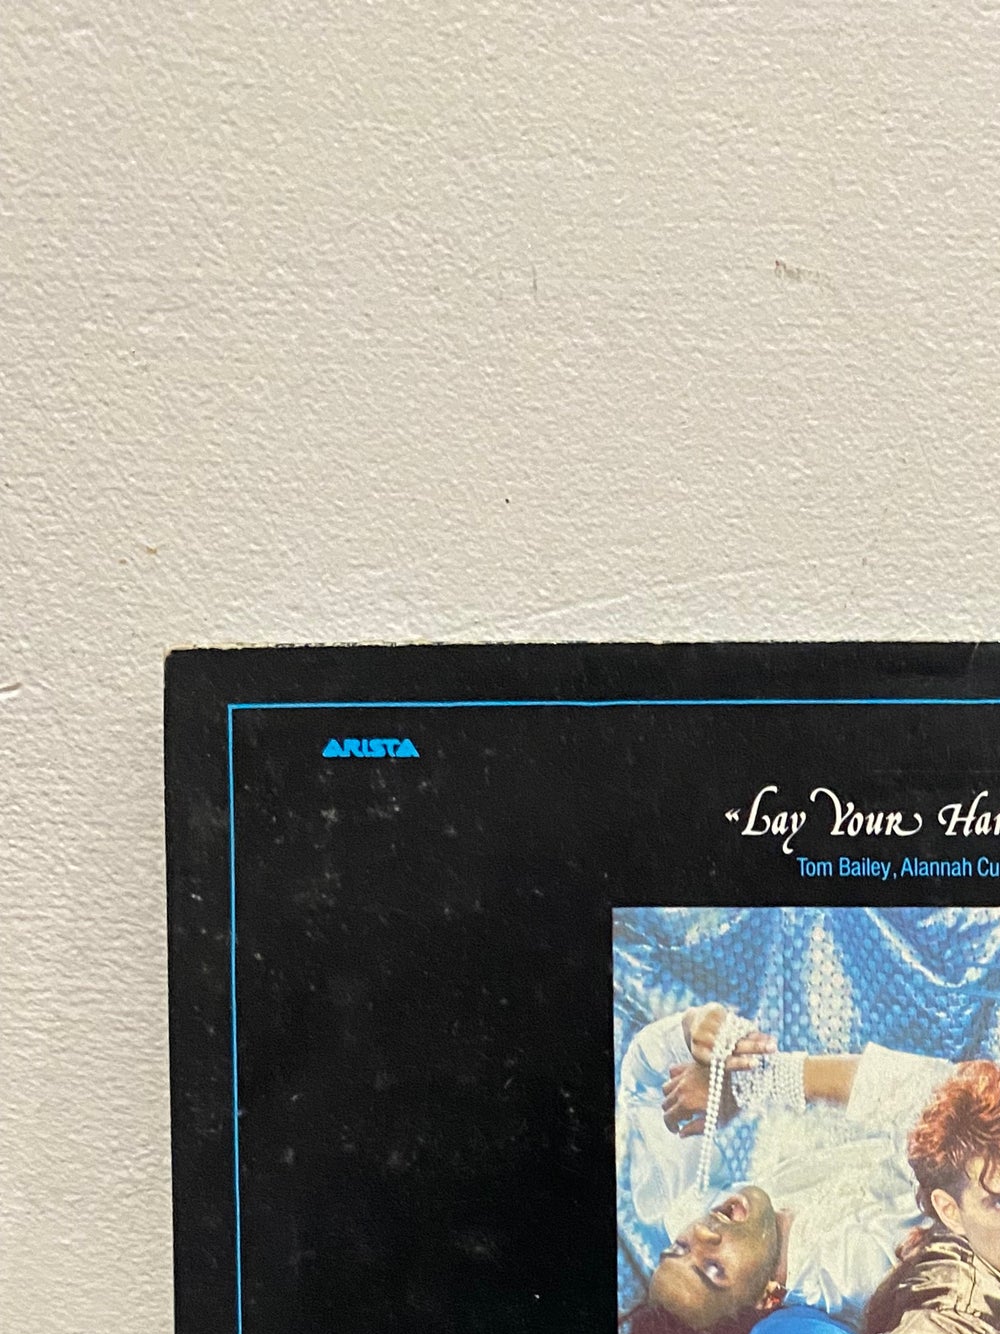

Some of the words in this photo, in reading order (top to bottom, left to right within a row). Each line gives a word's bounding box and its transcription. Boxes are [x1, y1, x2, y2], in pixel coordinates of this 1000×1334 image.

[322, 737, 420, 758] ARISTA
[809, 787, 923, 837] Your
[796, 856, 833, 877] Tom
[838, 856, 897, 881] Bailey,
[900, 856, 973, 878] Alannah
